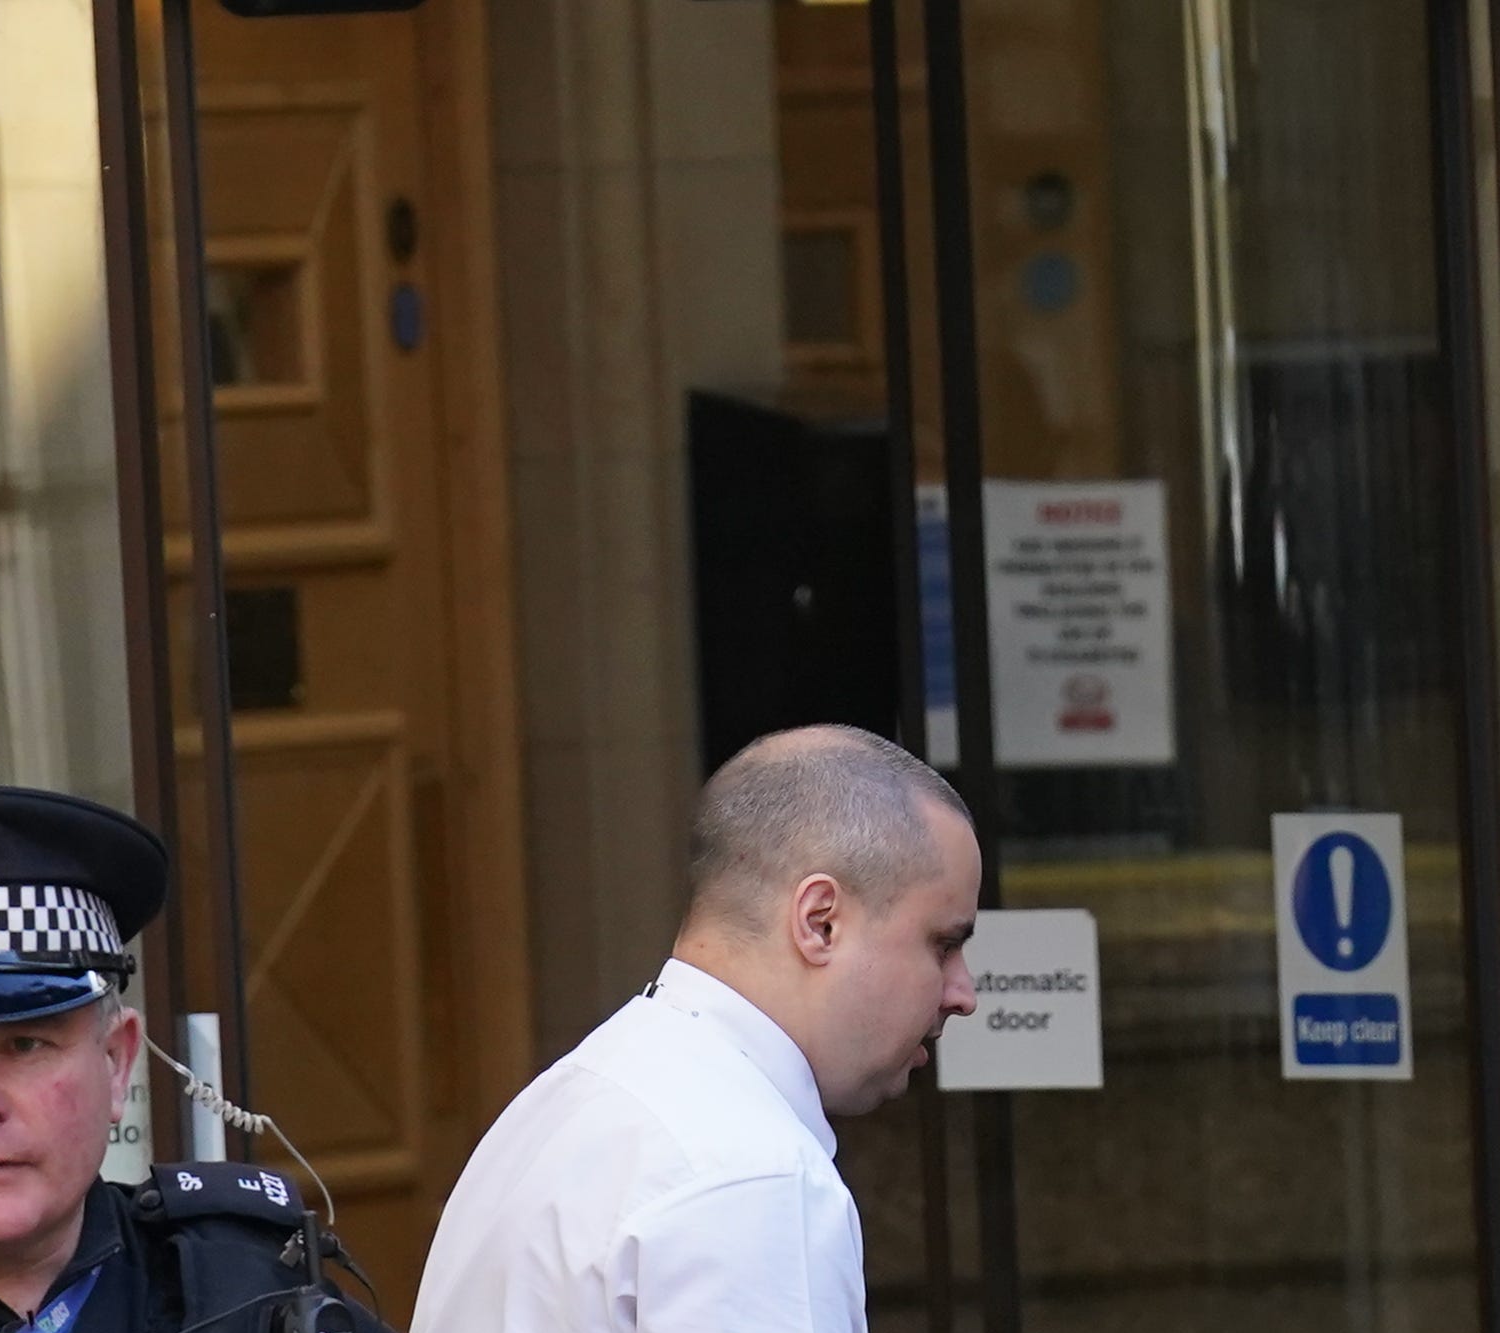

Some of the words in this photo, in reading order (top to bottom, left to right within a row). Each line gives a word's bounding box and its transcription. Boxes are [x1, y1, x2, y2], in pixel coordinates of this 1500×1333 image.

[987, 1006, 1051, 1031] door
[1297, 1015, 1348, 1048] Keep
[1350, 1016, 1398, 1043] clear
[177, 1171, 204, 1192] SP
[238, 1178, 261, 1192] E
